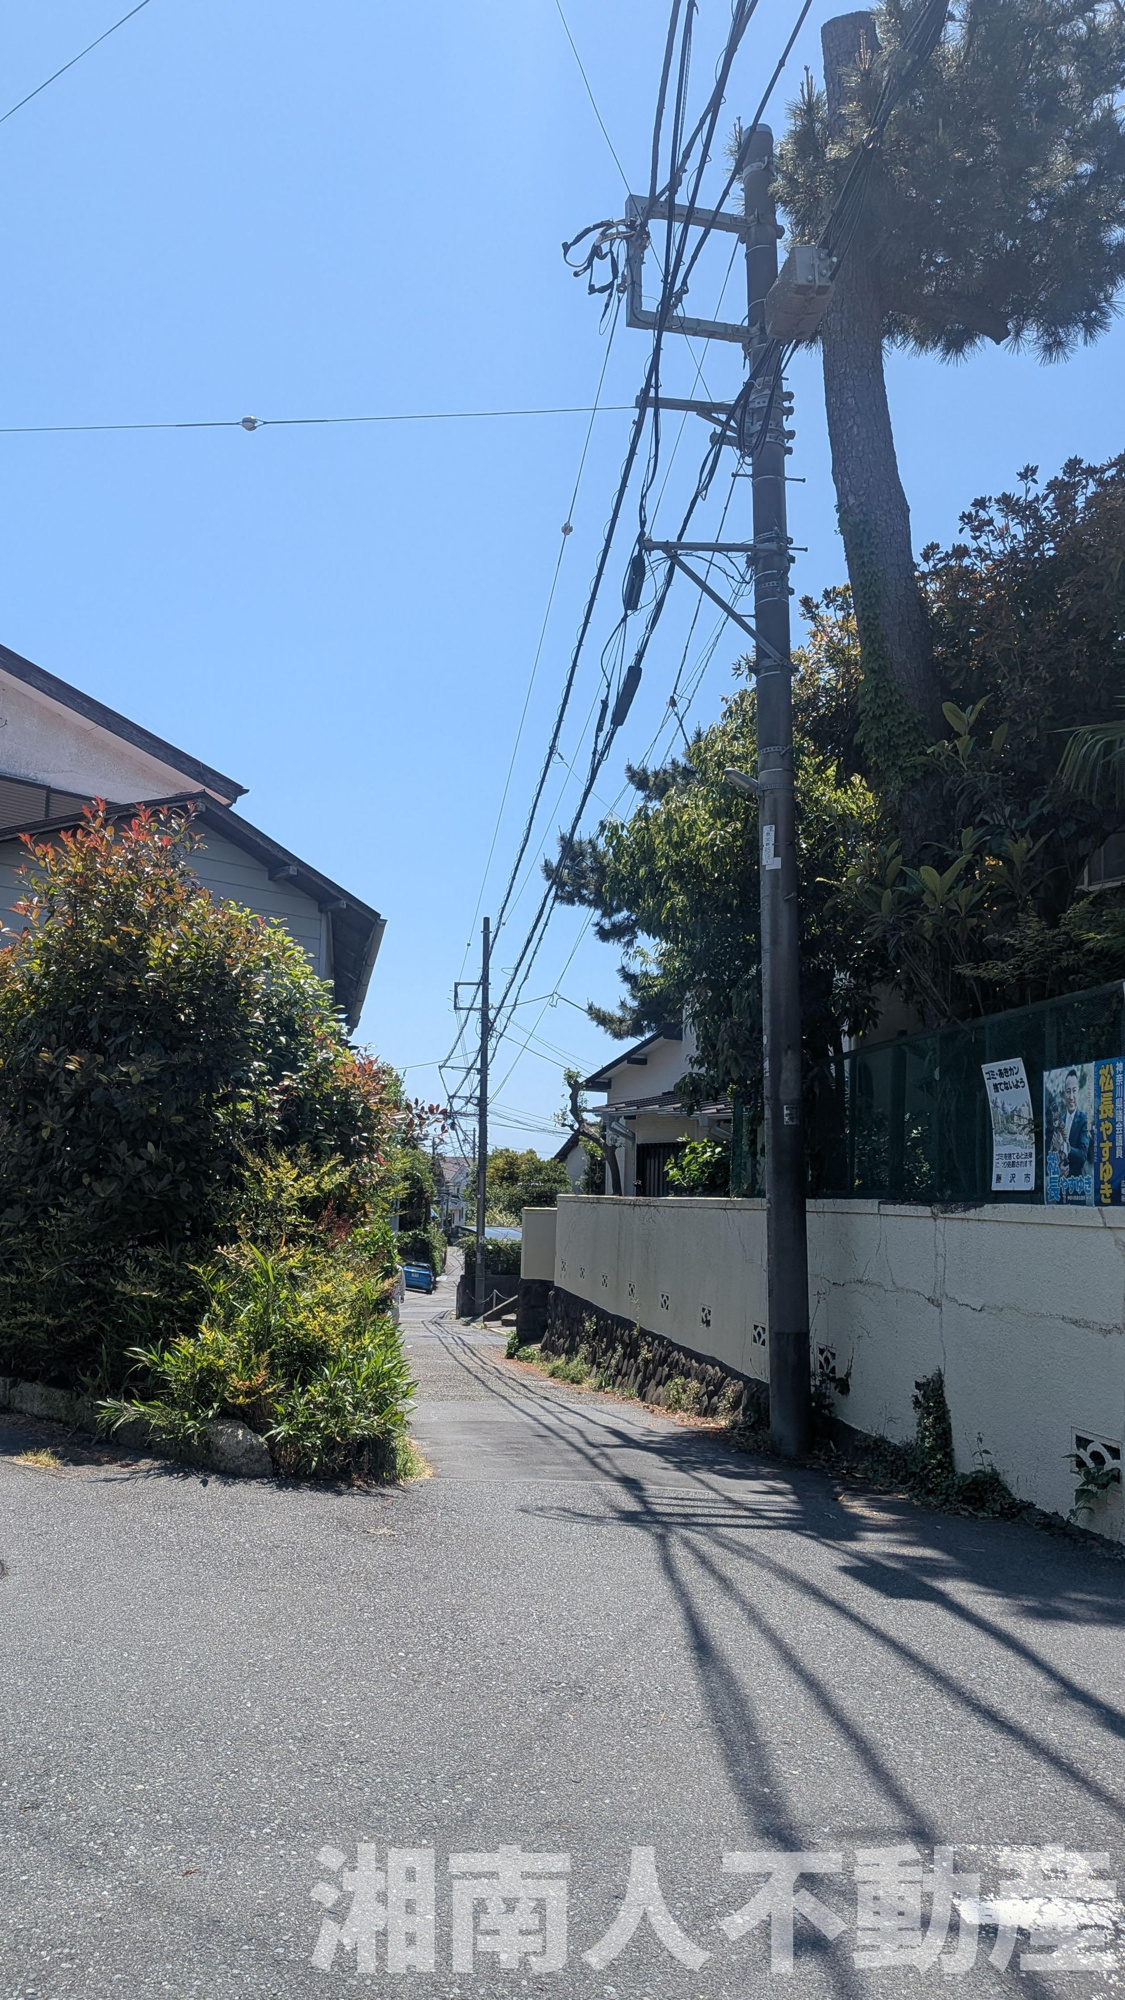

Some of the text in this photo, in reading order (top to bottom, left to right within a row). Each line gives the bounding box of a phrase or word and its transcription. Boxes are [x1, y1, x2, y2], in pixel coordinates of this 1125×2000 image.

[1115, 1061, 1124, 1158] 神奈川県議会議員
[1060, 1175, 1092, 1194] やすゆき
